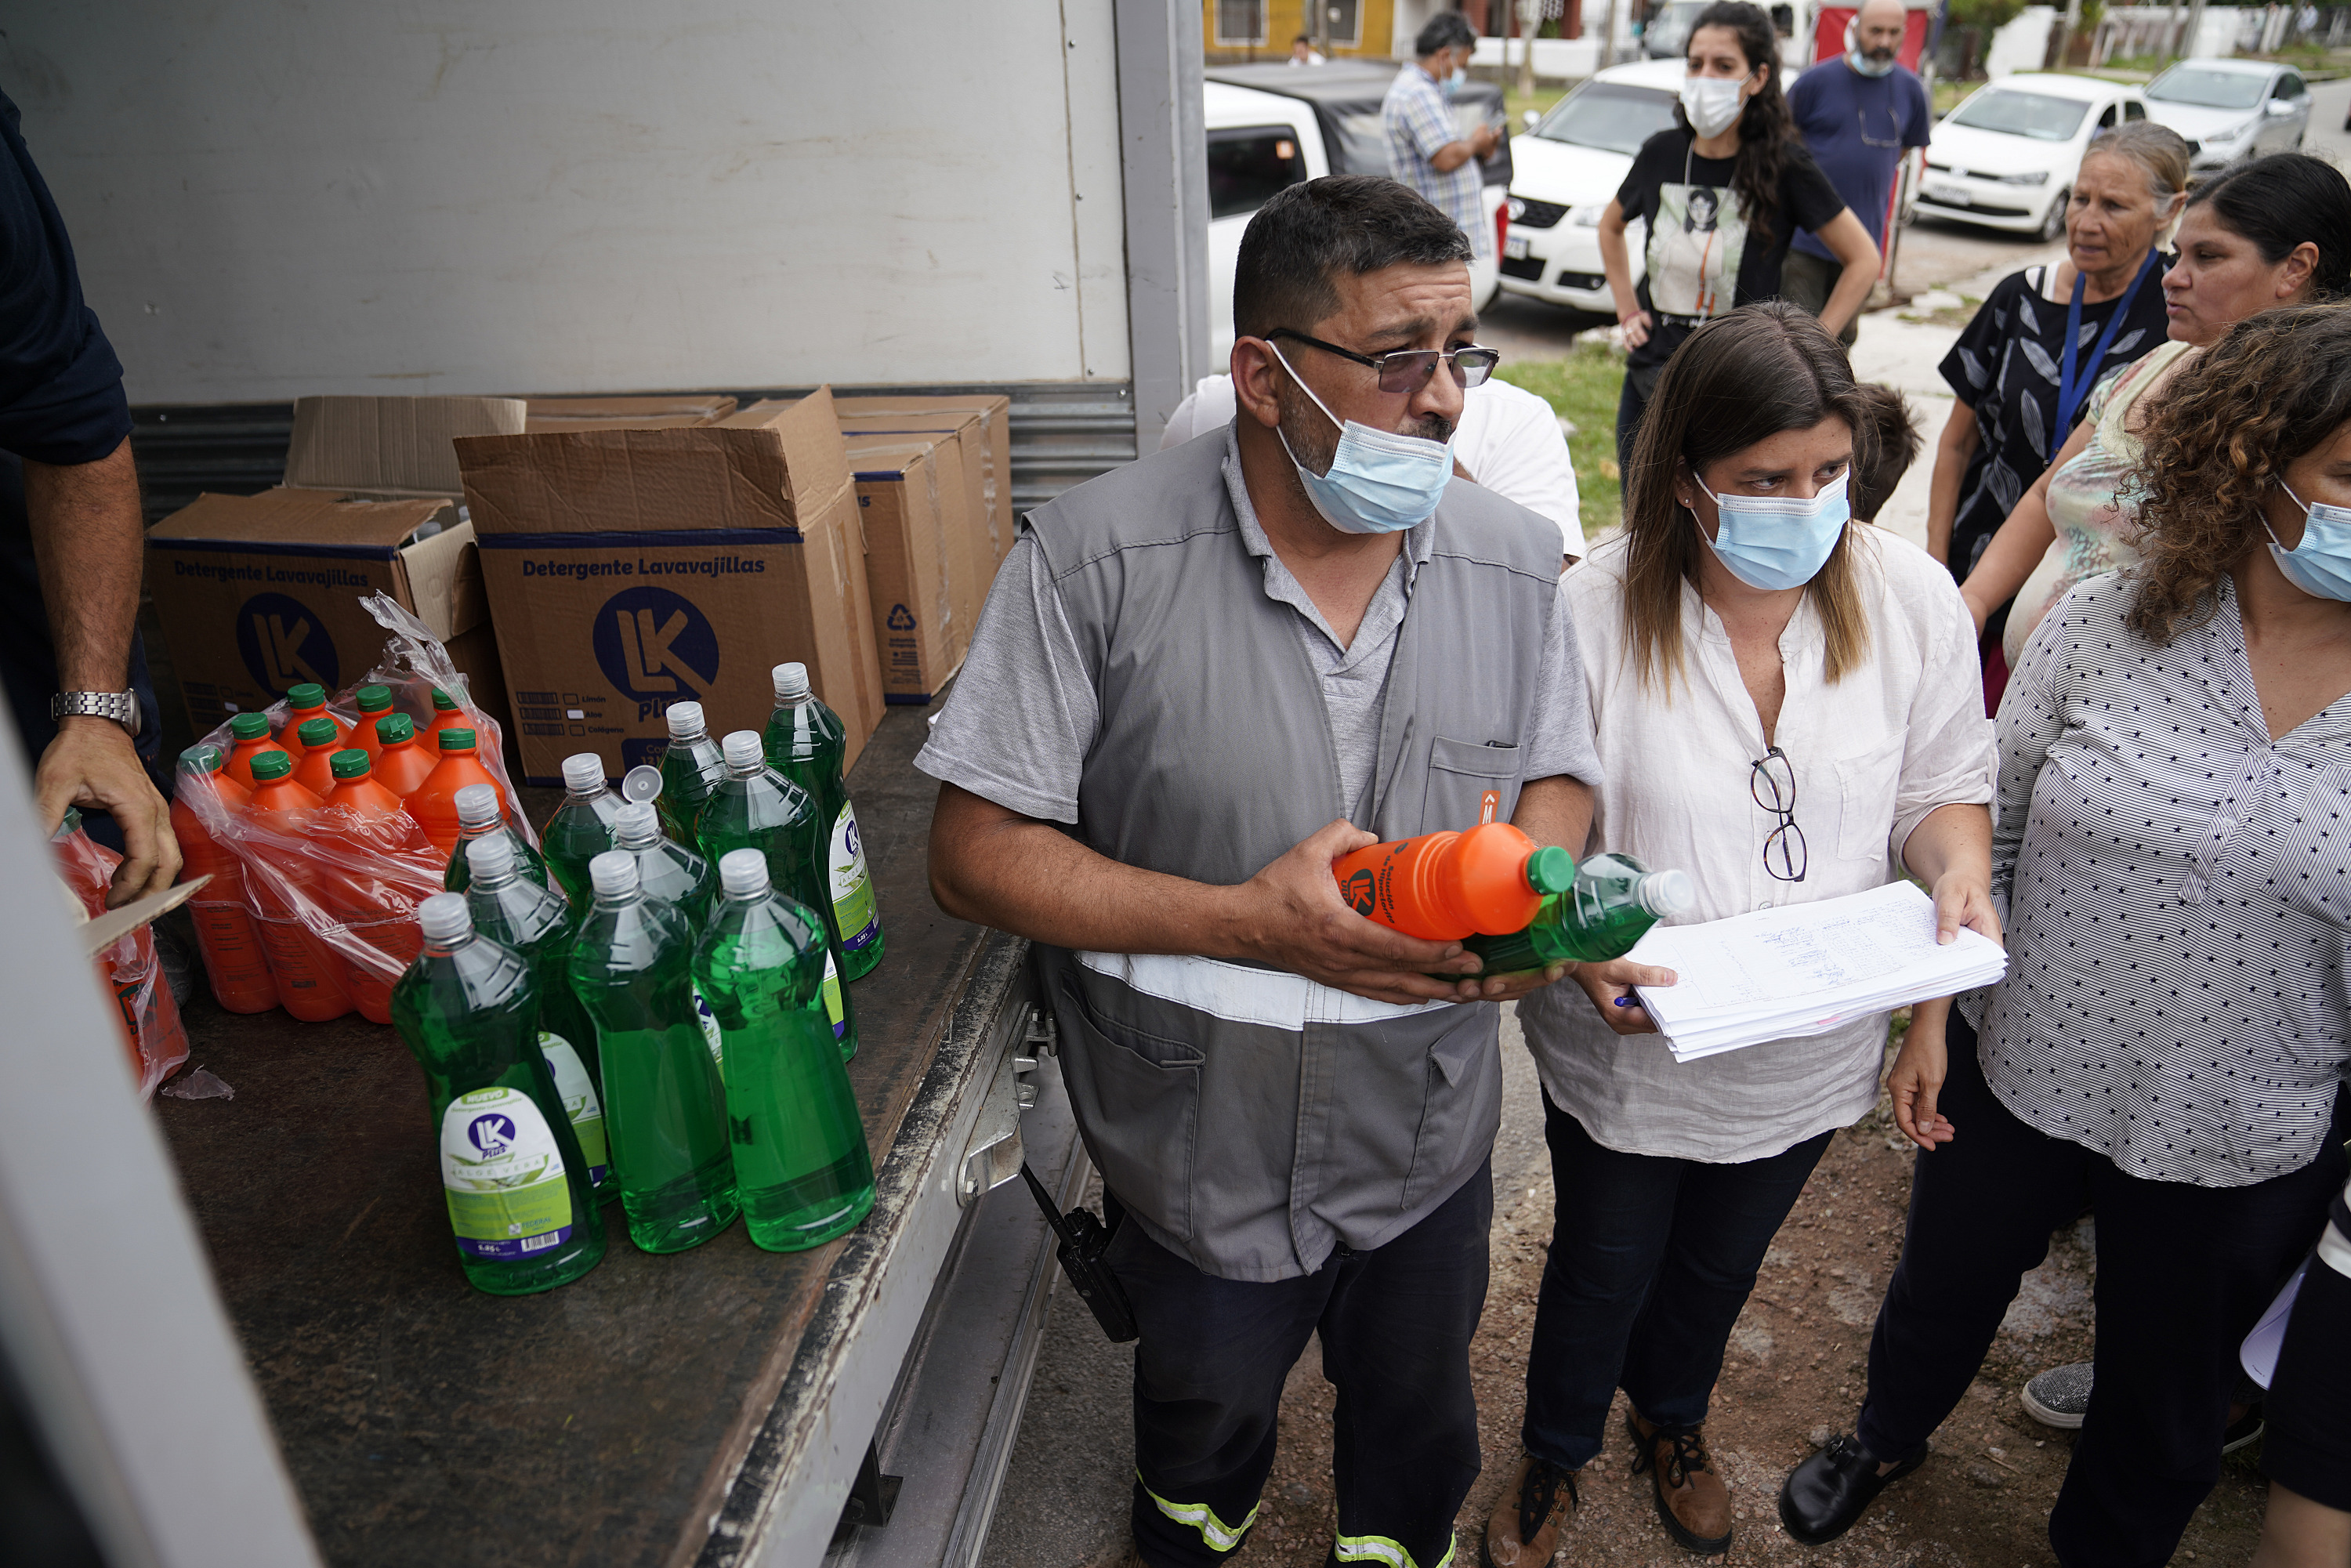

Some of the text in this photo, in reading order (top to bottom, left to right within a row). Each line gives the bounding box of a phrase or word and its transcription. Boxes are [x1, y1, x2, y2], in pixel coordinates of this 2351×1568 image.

[174, 560, 368, 588] Detergente Lavavajillas
[522, 556, 766, 581] Detergente Lavavajillas
[616, 608, 709, 694] LK
[581, 695, 607, 704] Limón
[842, 867, 859, 884] ALOE
[1385, 865, 1394, 910] Solución
[465, 1088, 504, 1104] NUEVO
[476, 1117, 513, 1150] LK
